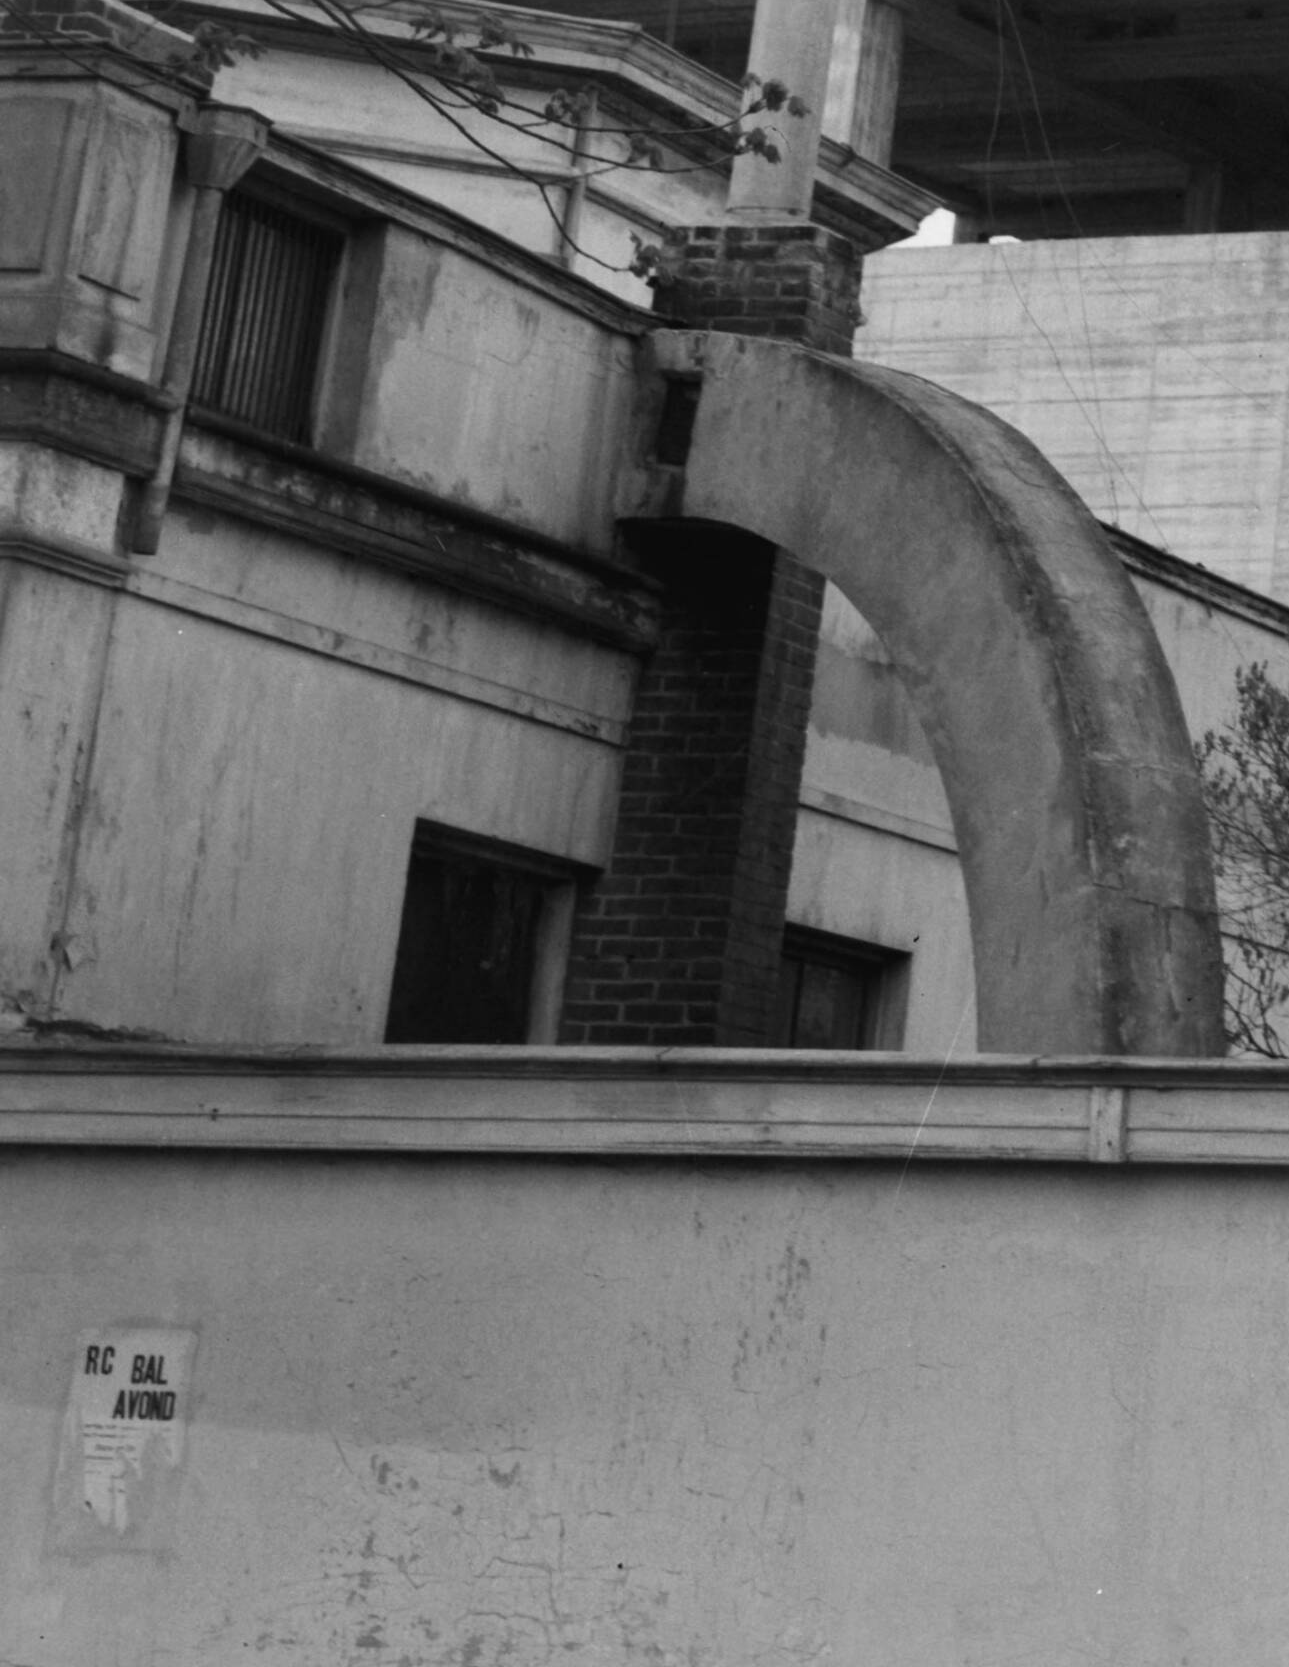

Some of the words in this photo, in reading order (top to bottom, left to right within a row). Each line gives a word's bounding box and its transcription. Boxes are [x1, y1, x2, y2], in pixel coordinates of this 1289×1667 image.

[85, 1345, 115, 1375] RC
[131, 1355, 167, 1385] BAL
[113, 1390, 175, 1421] AVOND
